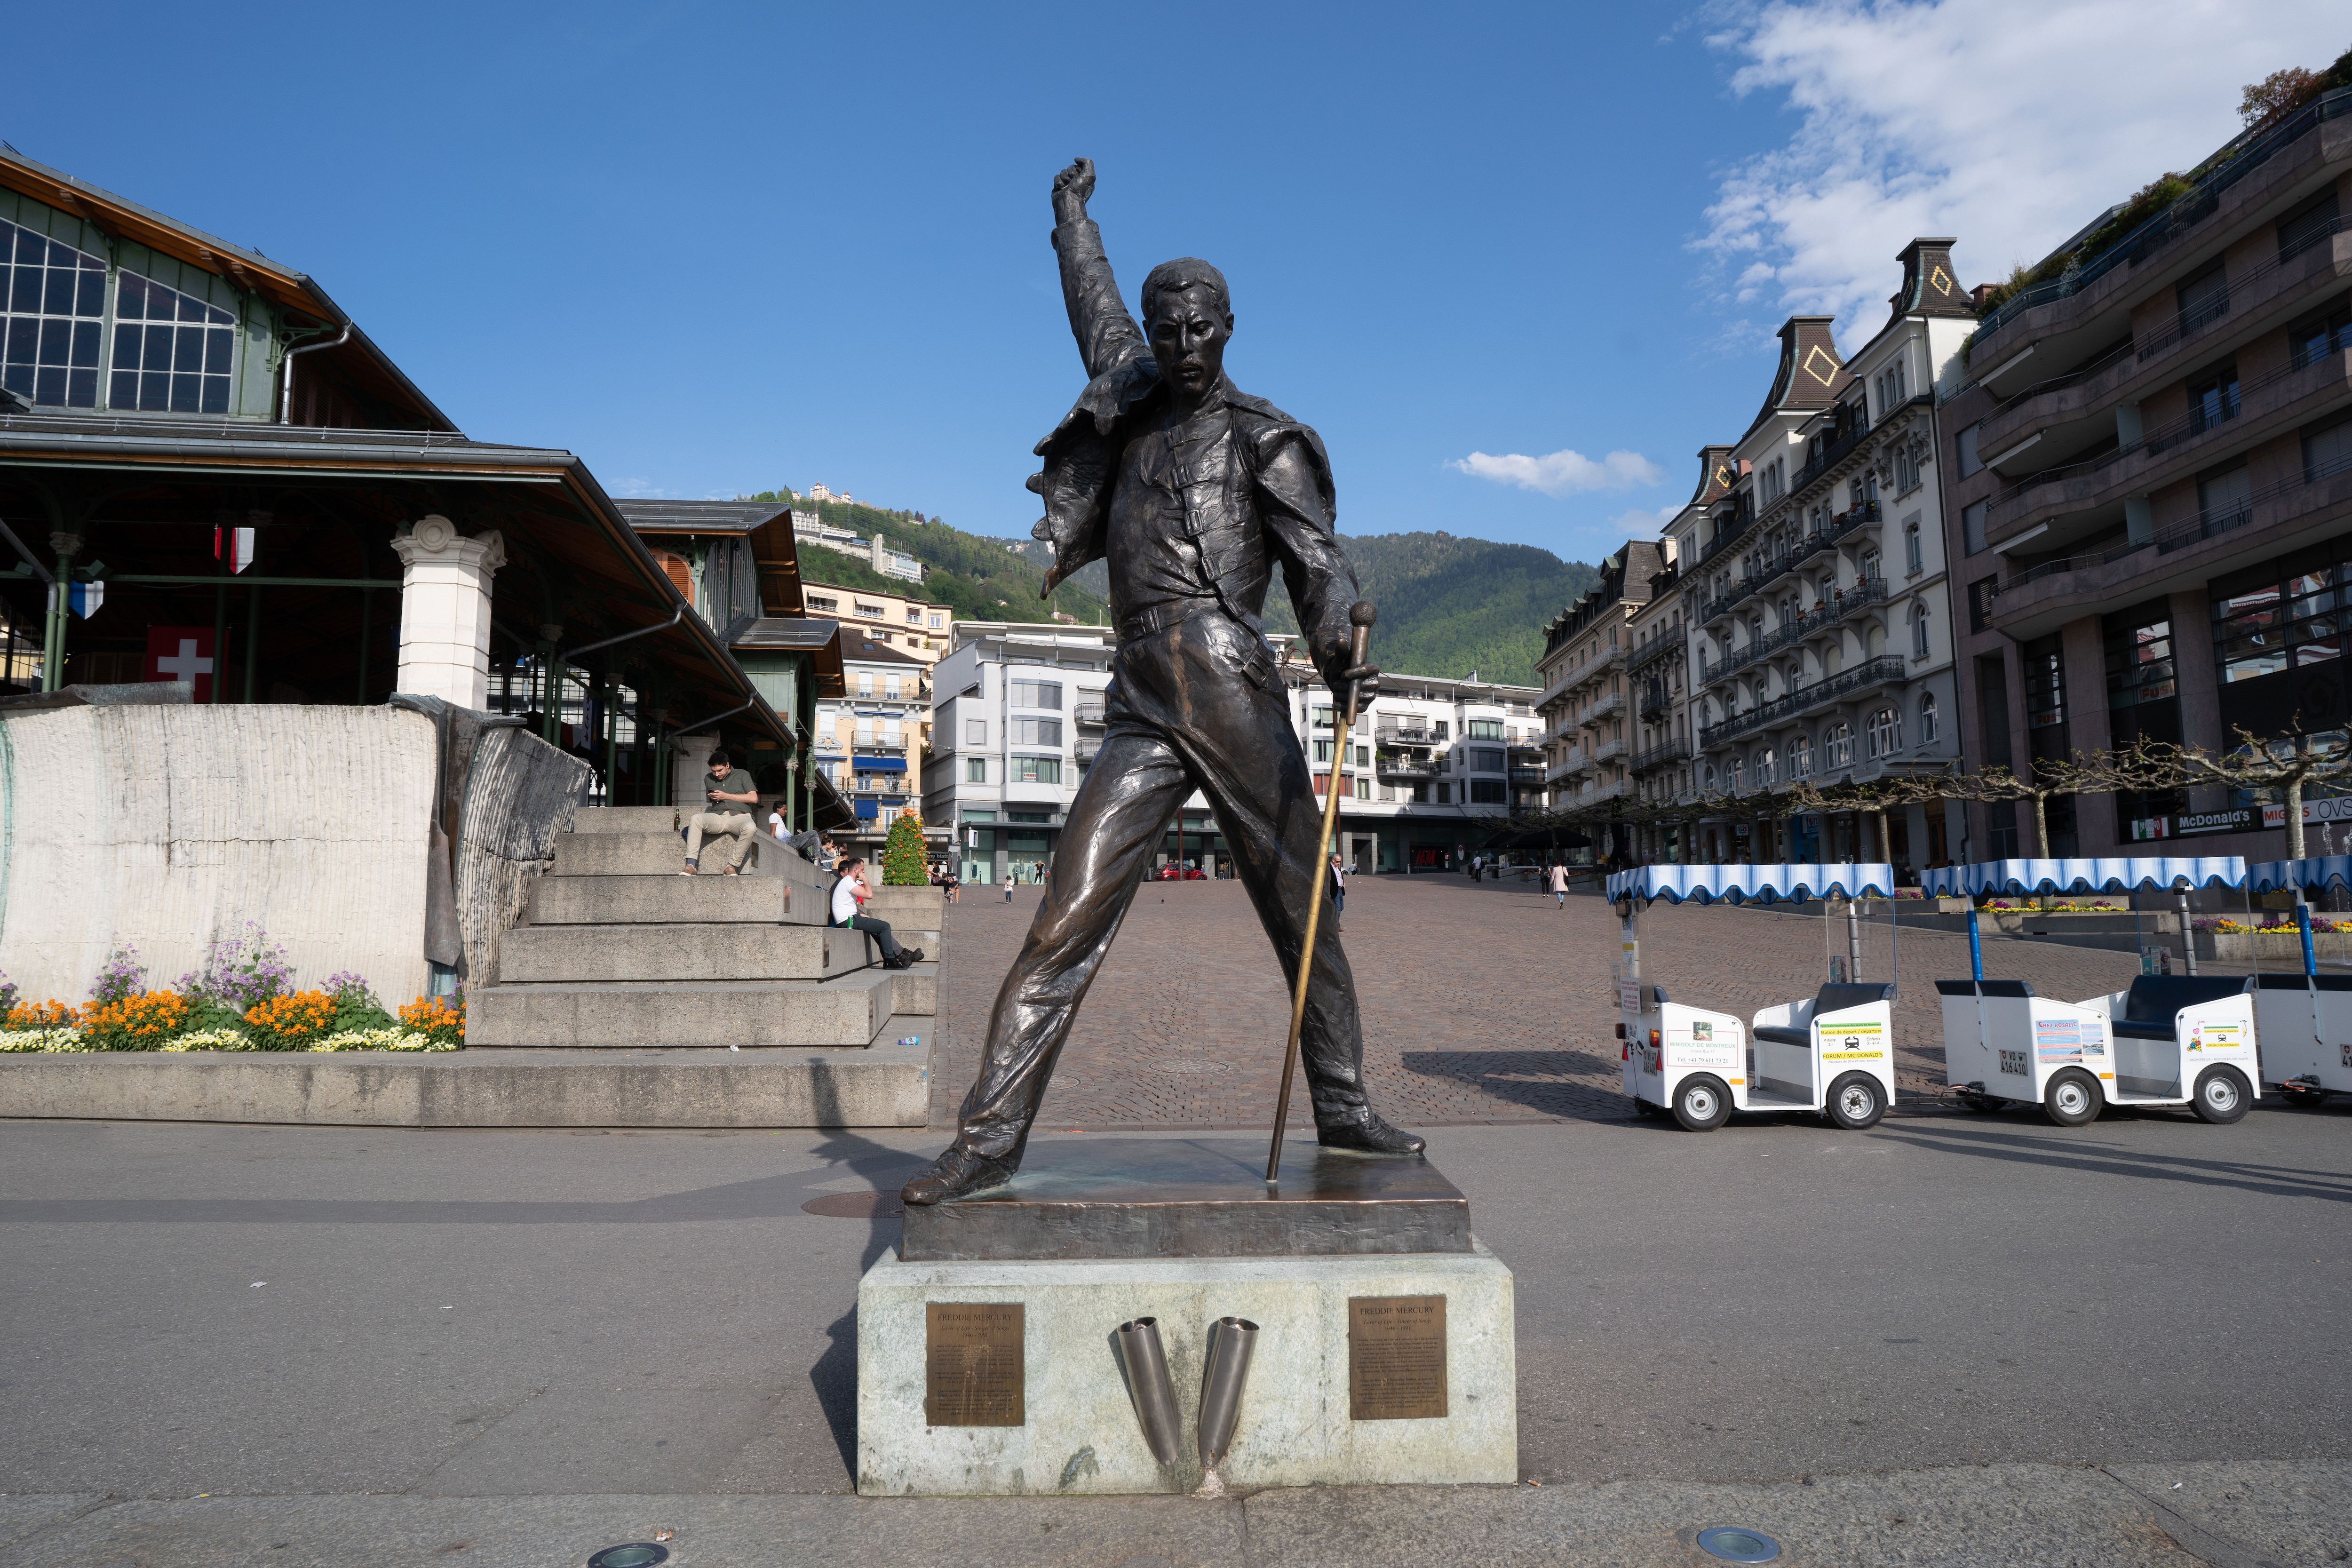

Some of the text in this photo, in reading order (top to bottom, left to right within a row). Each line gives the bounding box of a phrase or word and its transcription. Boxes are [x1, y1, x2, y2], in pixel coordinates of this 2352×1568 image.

[2265, 807, 2310, 821] MIGS
[2318, 799, 2352, 818] OVS
[2140, 820, 2160, 832] MOLINO
[2179, 811, 2250, 828] McDonald's
[2009, 1051, 2016, 1061] VD
[2002, 1061, 2026, 1075] 416 410
